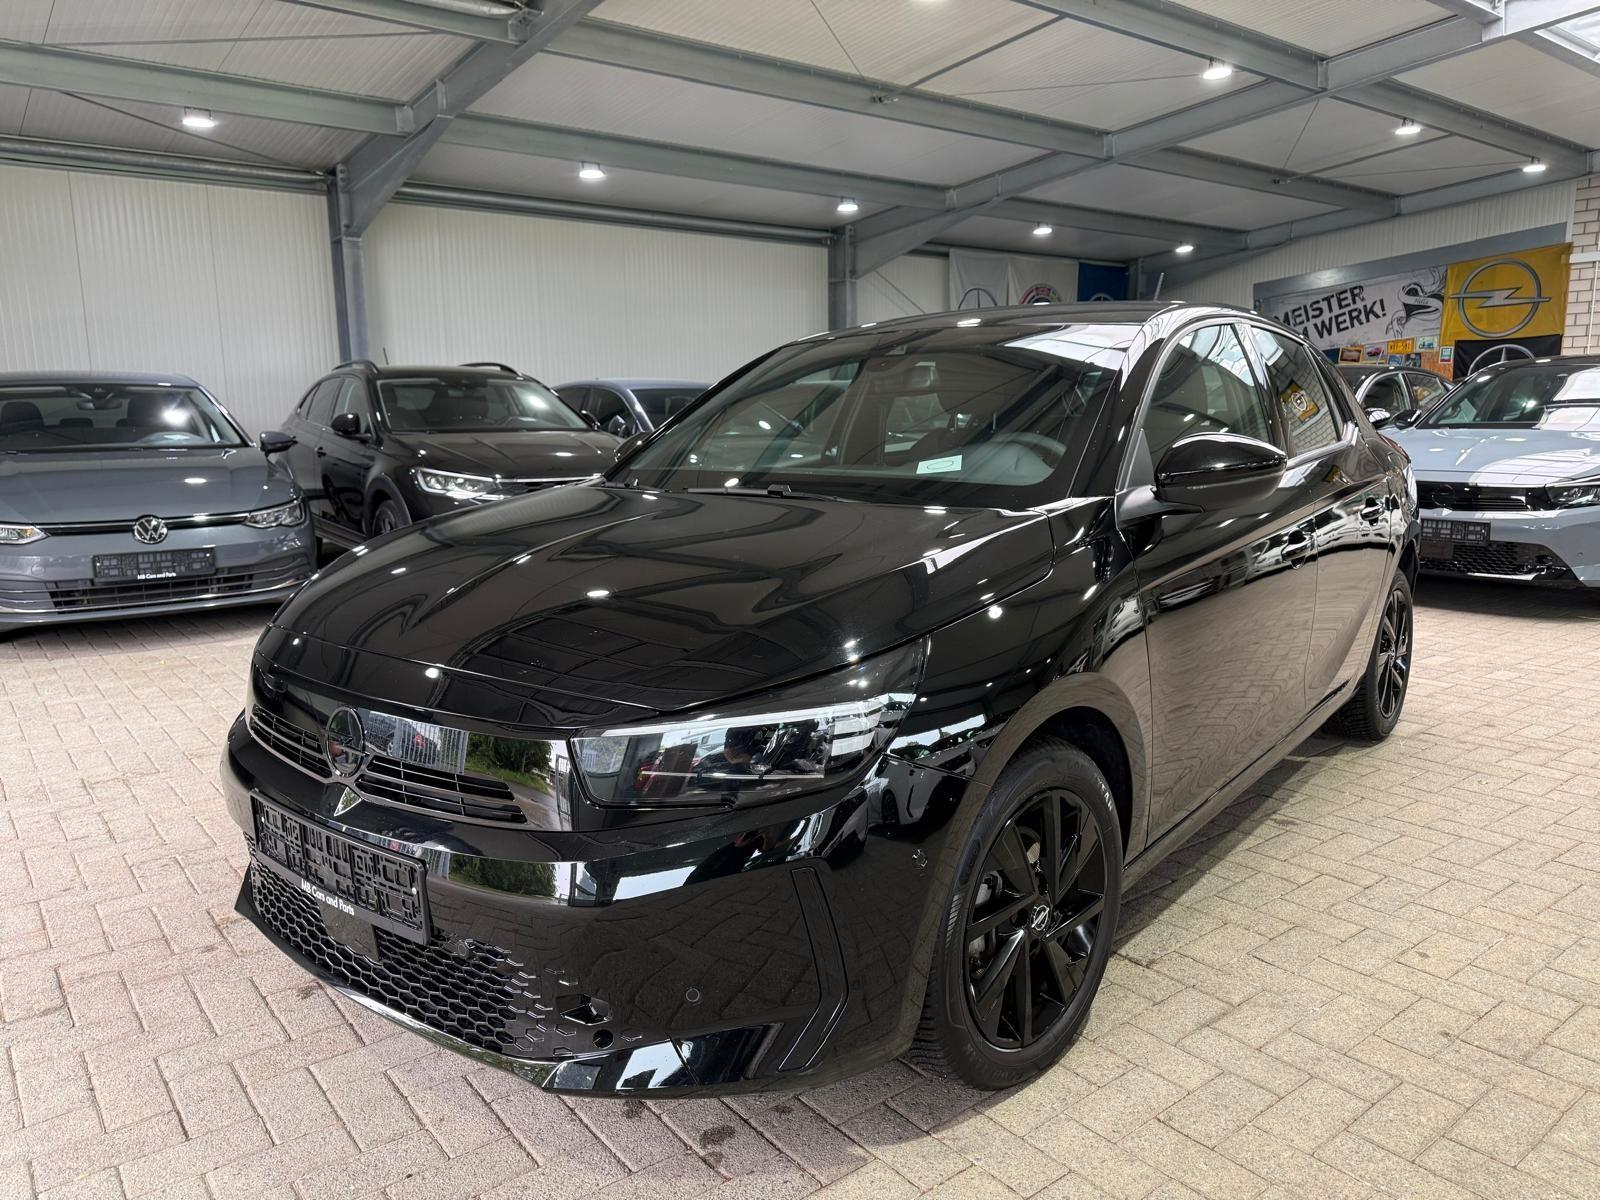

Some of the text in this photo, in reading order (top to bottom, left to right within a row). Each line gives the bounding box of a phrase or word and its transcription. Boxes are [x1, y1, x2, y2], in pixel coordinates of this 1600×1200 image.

[1274, 285, 1365, 327] MEISTER
[1313, 298, 1387, 339] WERK!
[301, 878, 355, 916] MB Cars and Parts
